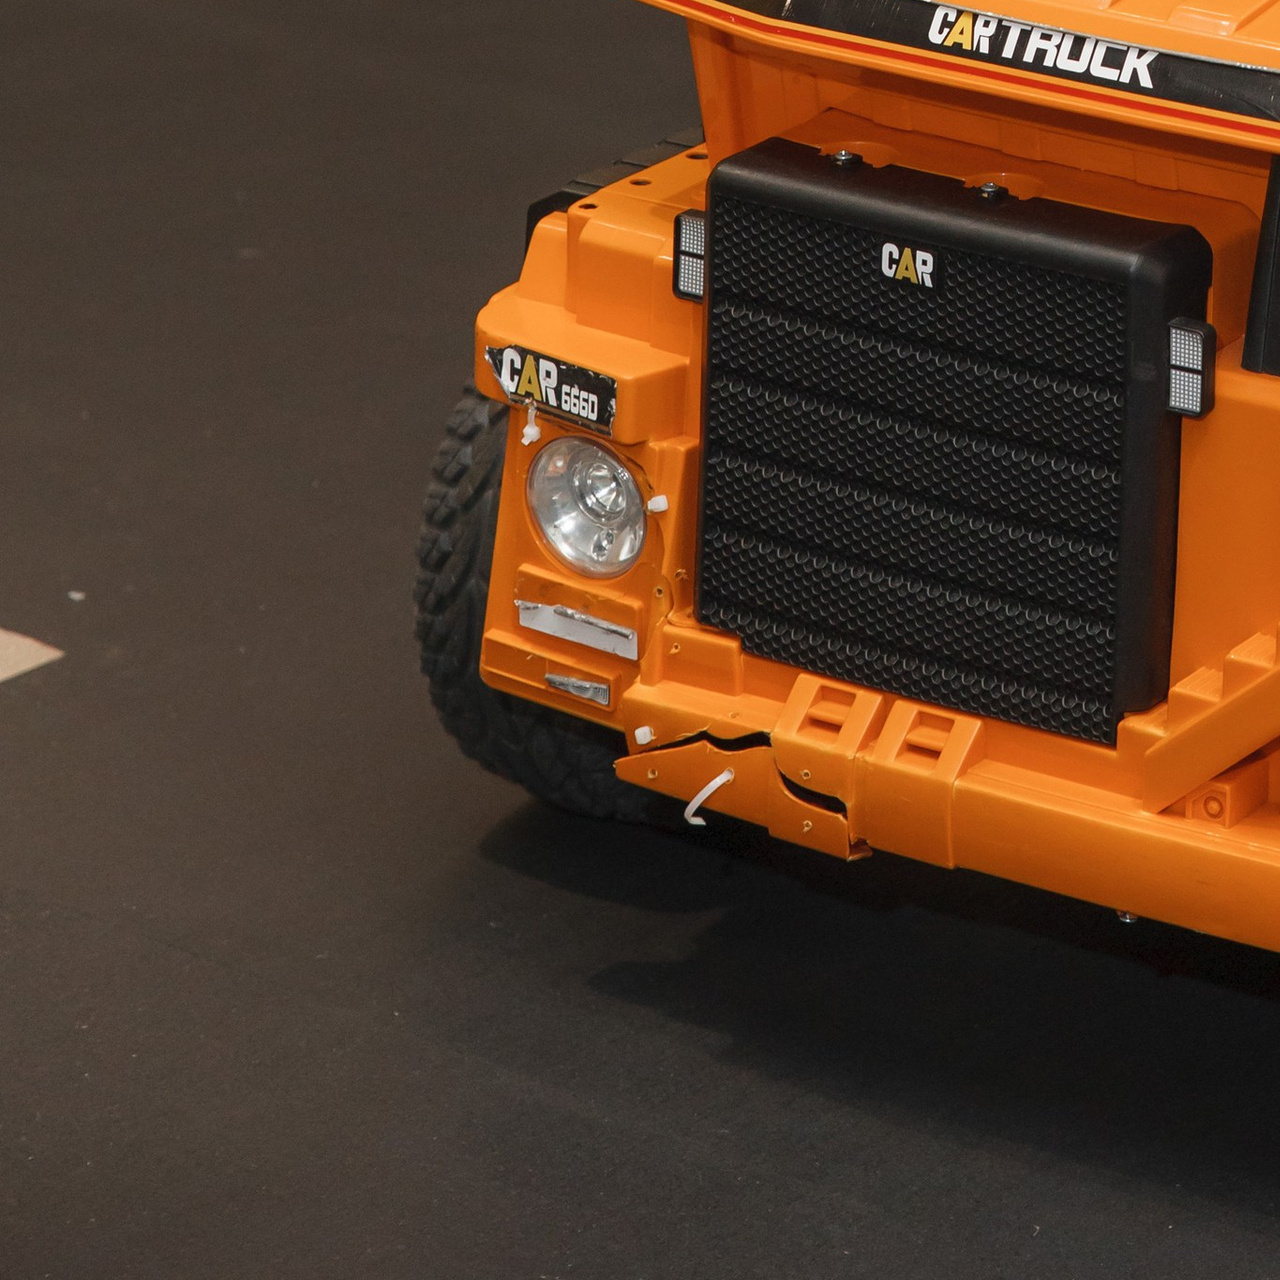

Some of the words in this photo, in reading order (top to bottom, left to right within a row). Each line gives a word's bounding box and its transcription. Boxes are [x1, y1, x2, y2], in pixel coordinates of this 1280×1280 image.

[881, 242, 934, 288] CAR
[501, 347, 558, 407] CAR
[560, 383, 599, 421] 666D
